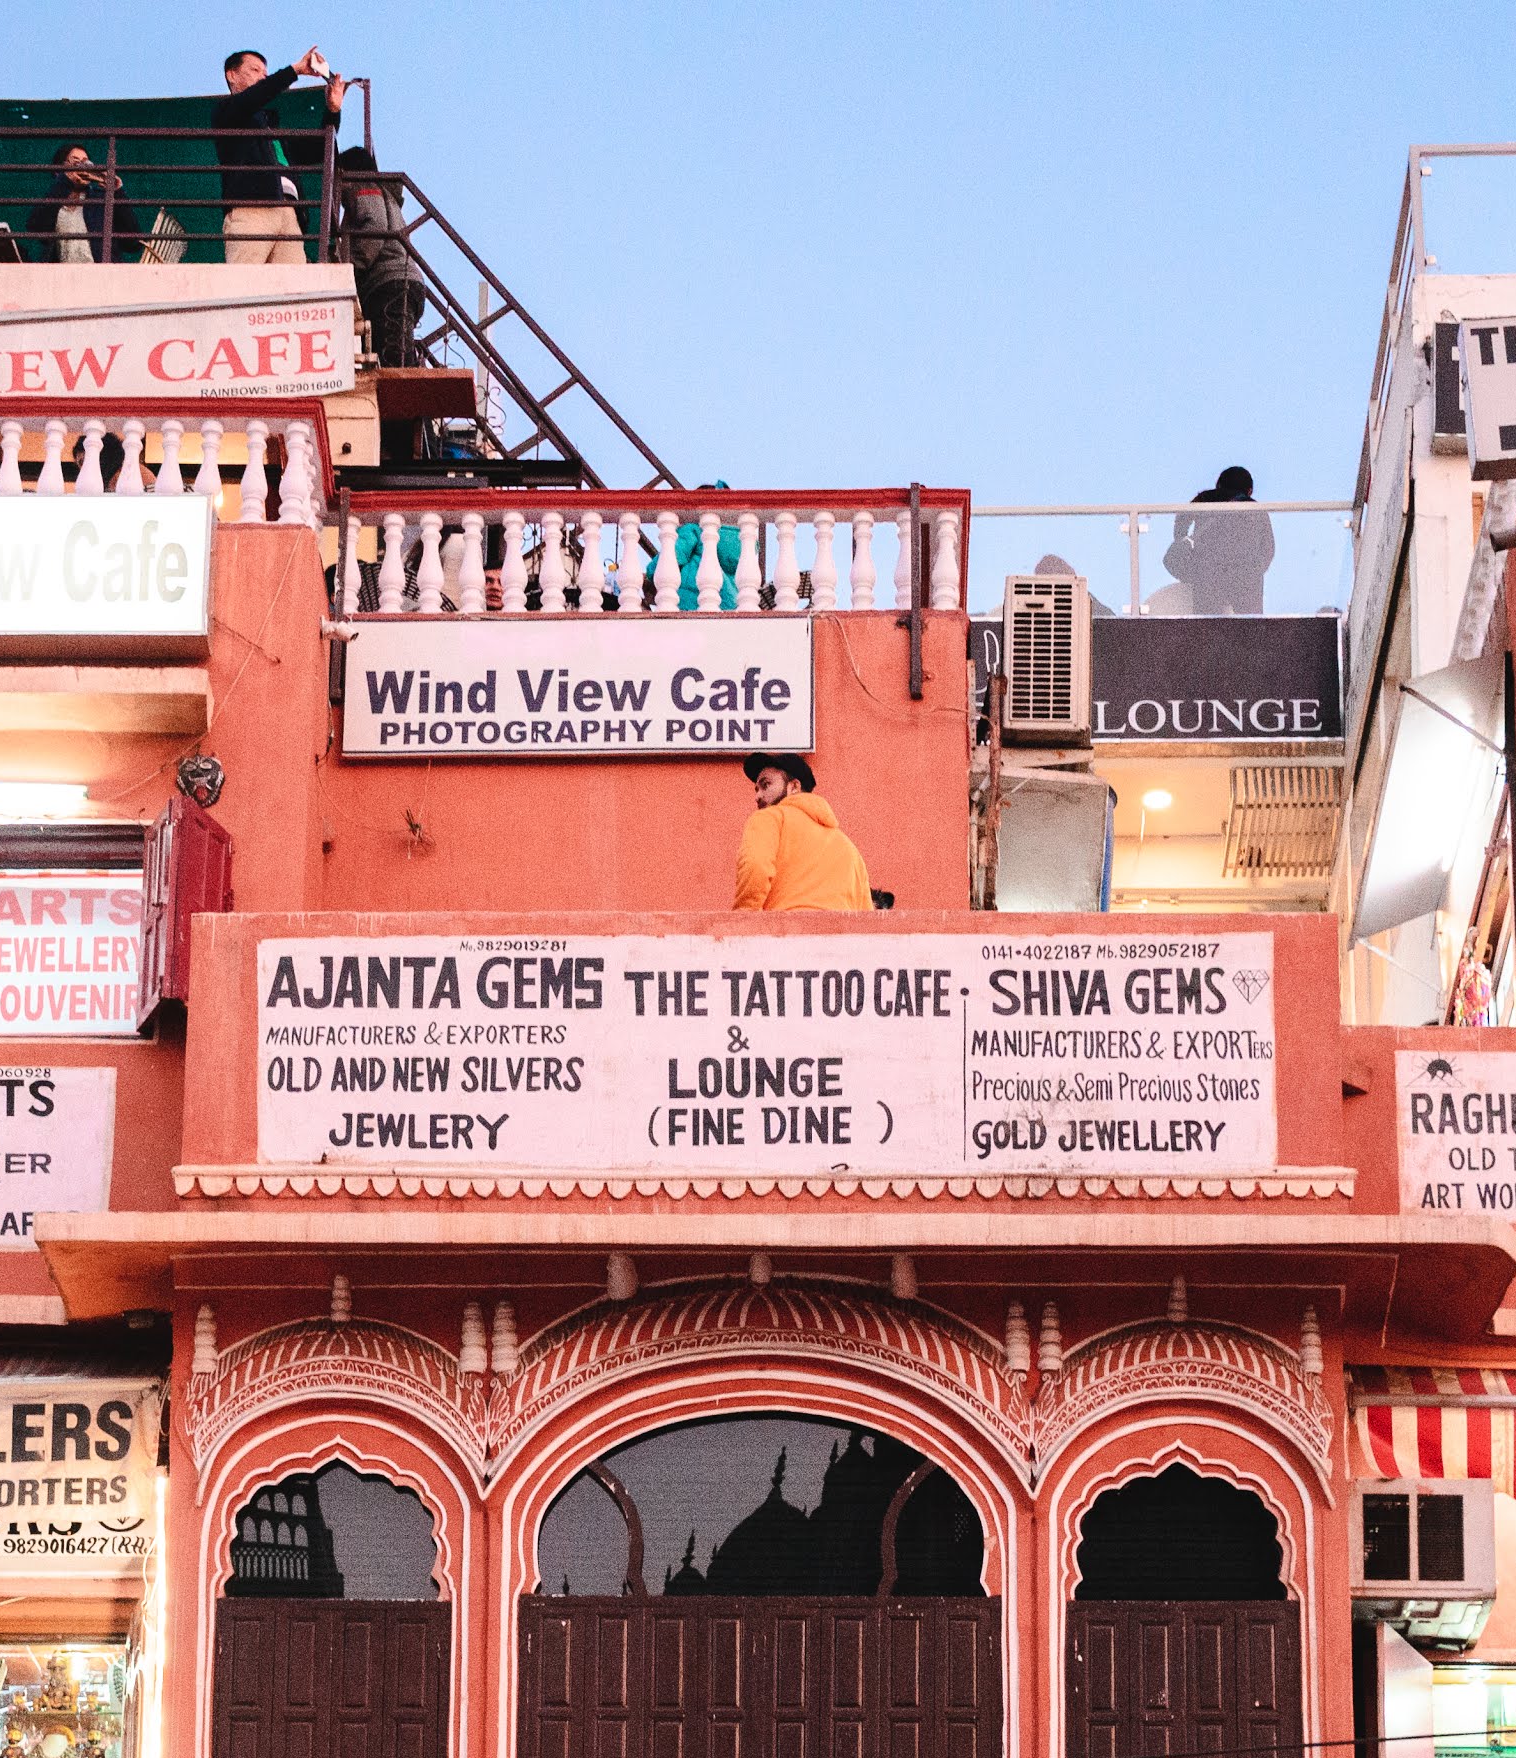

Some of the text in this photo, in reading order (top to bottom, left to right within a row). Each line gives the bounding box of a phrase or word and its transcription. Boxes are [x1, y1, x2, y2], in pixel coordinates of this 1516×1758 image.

[248, 308, 336, 326] 9829019281
[147, 330, 336, 383] CAFE
[276, 380, 343, 394] 9829016400
[64, 519, 188, 604] Cafe
[366, 666, 791, 715] Wind View Cafe
[381, 718, 775, 745] PHOTOGRAPHY POINT
[1093, 699, 1322, 733] LOUNGE
[267, 956, 604, 1009] AJANTA GEMS
[624, 969, 951, 1017] THE TATTOO CAFE
[991, 968, 1226, 1015] SHIVA GEMS
[267, 1025, 567, 1046] MANUFACTURERS EXPORTERS
[972, 1031, 1272, 1061] MANUFACTURERS EXPORTERS
[268, 1057, 584, 1092] OLD AND NEW SILVERS
[669, 1057, 843, 1099] LOUNGE
[972, 1072, 1259, 1102] Precious Semi Precious Stones
[329, 1113, 509, 1150] JEWLERY
[972, 1121, 1226, 1158] GOLD JEWELLERY
[1449, 1148, 1495, 1171] OLD
[1421, 1184, 1464, 1208] ART
